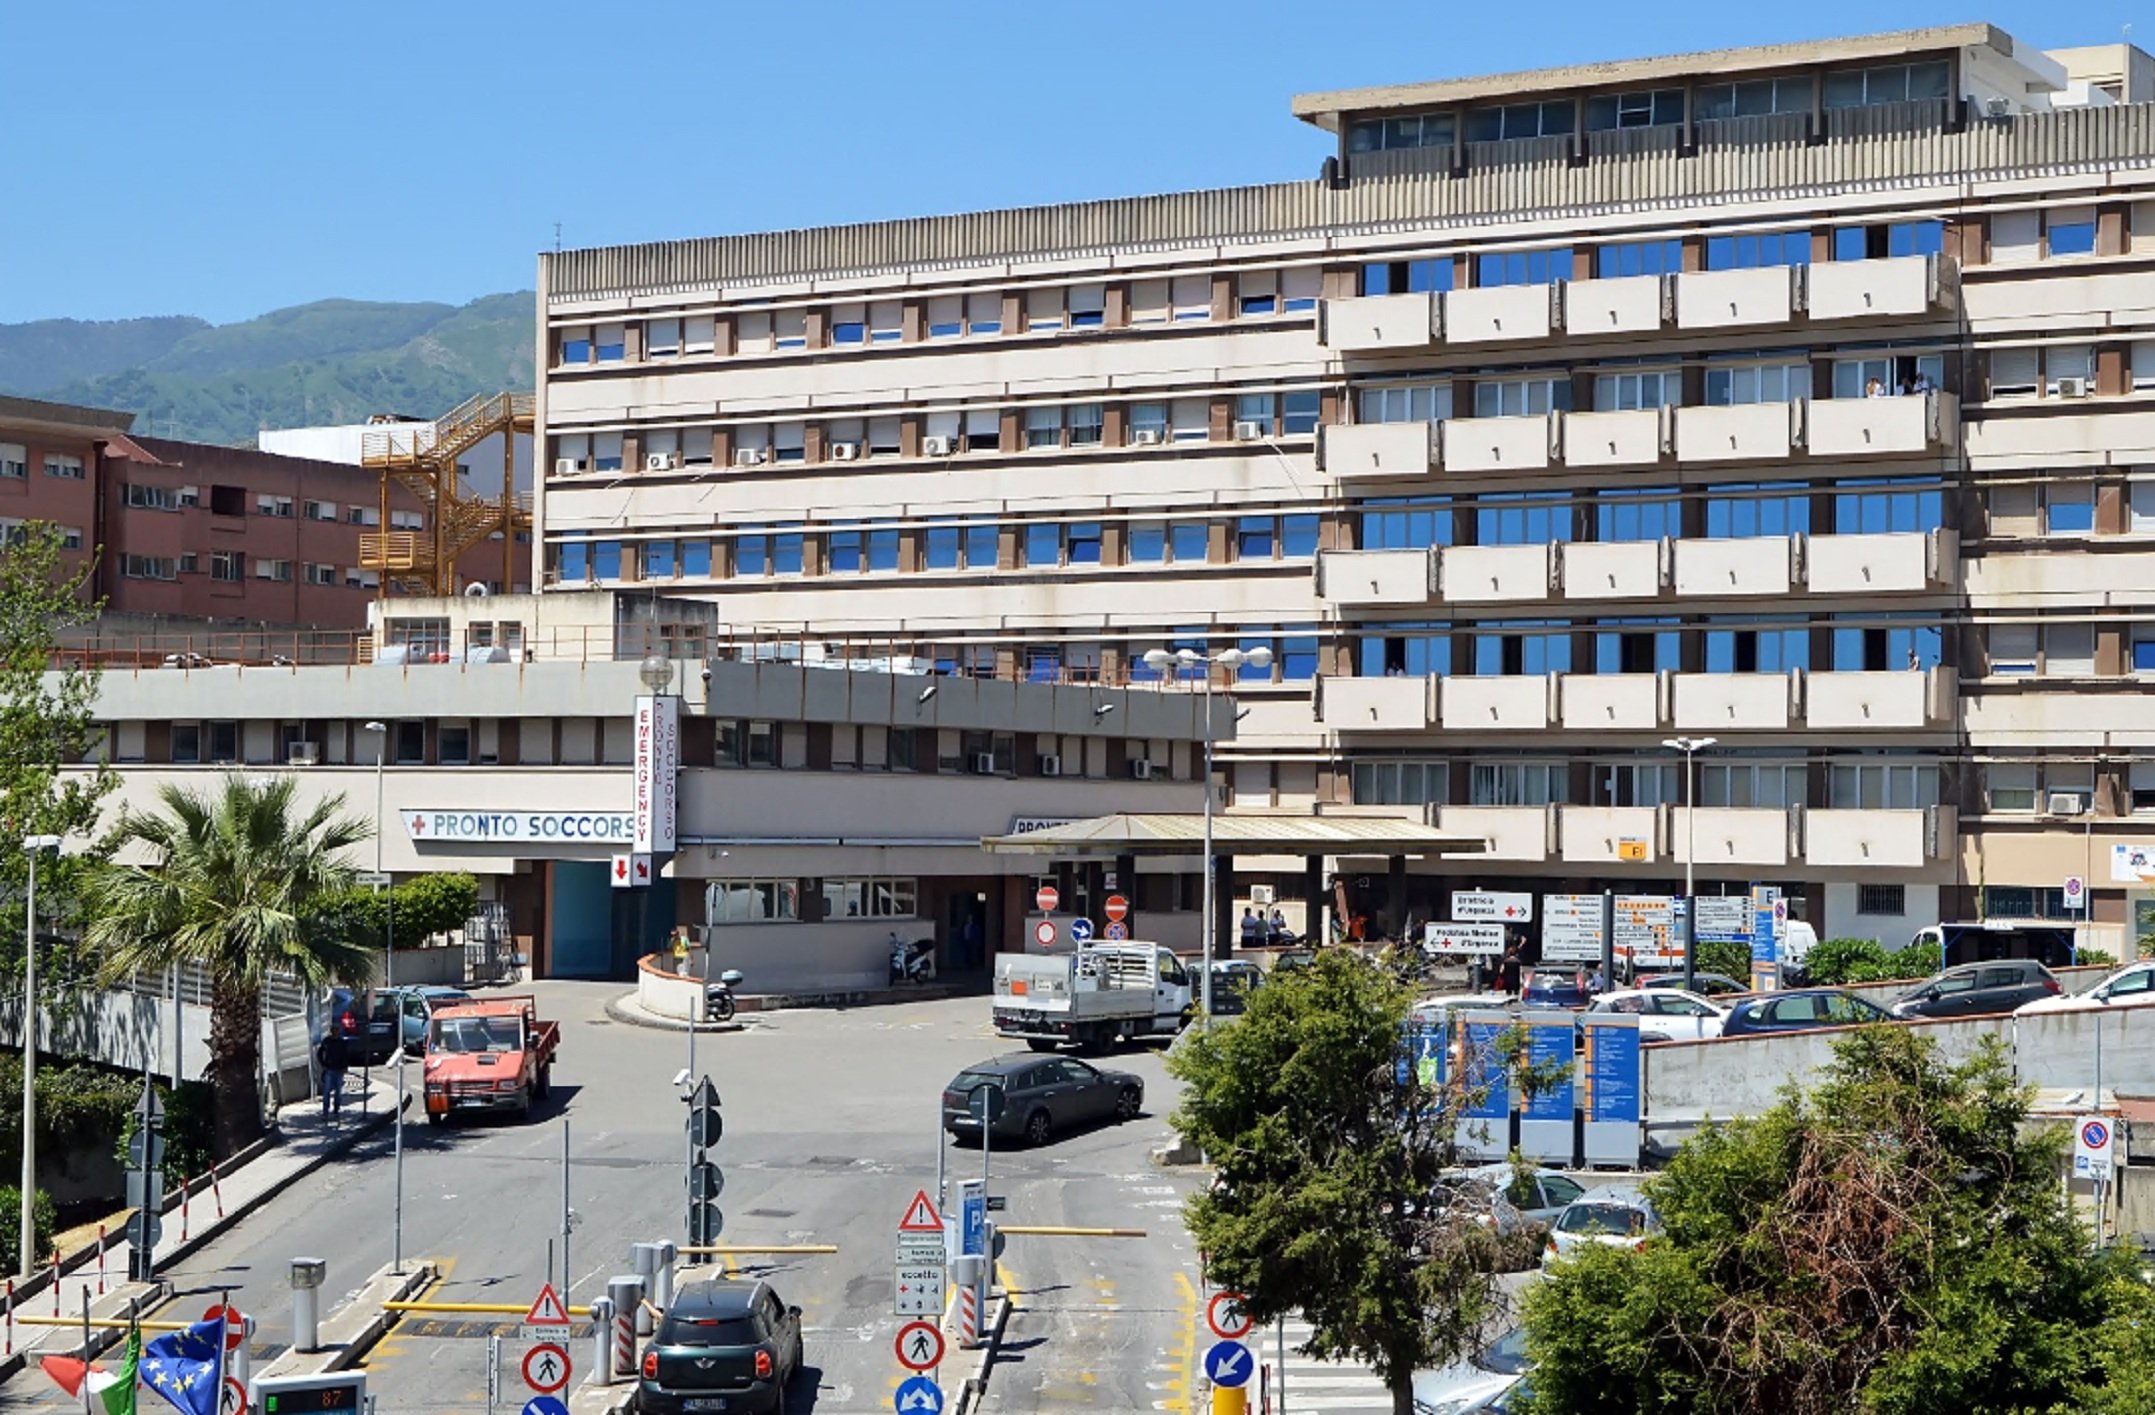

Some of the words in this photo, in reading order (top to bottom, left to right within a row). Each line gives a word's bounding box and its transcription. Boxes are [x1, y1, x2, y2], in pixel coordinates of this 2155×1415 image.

[654, 701, 664, 785] PRONTO
[638, 709, 650, 842] EMERGENCY
[664, 723, 675, 840] SOCCORSO
[433, 814, 518, 837] PRONTO
[971, 1210, 981, 1232] P
[901, 1269, 938, 1280] eccetto
[322, 1389, 342, 1407] 87
